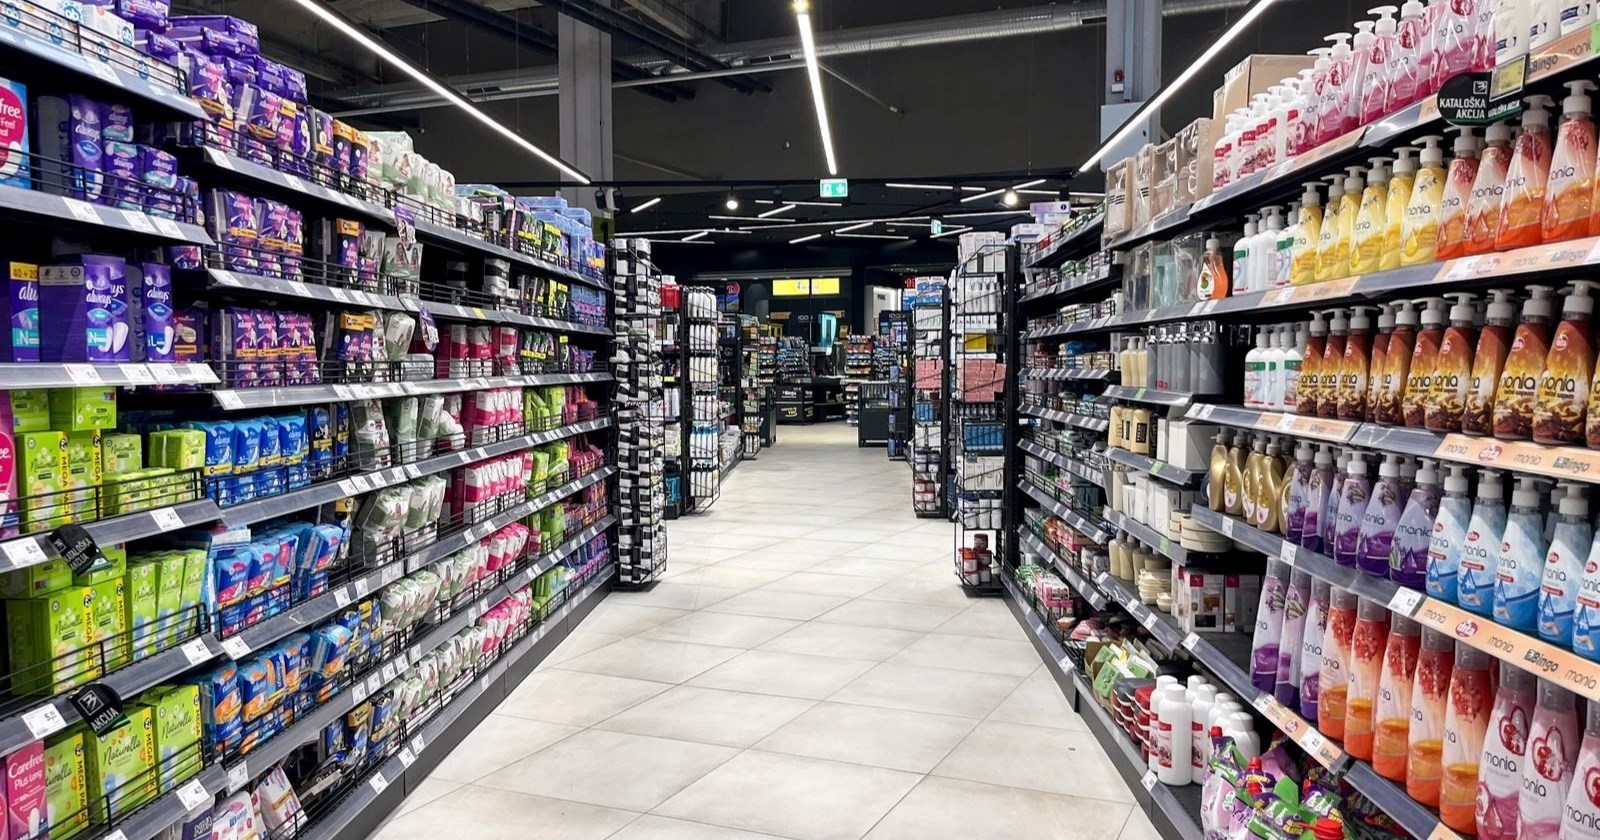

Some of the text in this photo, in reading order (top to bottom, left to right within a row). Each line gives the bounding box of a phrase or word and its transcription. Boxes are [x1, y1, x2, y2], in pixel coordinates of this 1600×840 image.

[1567, 40, 1592, 57] moni
[1532, 54, 1558, 73] Bingo
[1440, 97, 1486, 109] KATALOŠKA
[1456, 109, 1485, 119] AKCIJA
[75, 122, 100, 142] always
[1551, 165, 1576, 181] onia
[1506, 176, 1526, 190] onia
[1442, 197, 1460, 209] onia
[1356, 220, 1371, 231] onia
[86, 292, 112, 308] always
[146, 287, 170, 303] always
[1301, 373, 1318, 384] onia
[1321, 374, 1337, 384] onia
[1341, 373, 1358, 384] onia
[1513, 453, 1542, 466] monia
[1562, 457, 1591, 473] Bingo
[61, 456, 69, 488] MEGA
[1363, 512, 1386, 526] onia
[1431, 536, 1449, 549] onia
[1464, 544, 1487, 558] onia
[1499, 556, 1516, 570] onia
[1545, 567, 1567, 582] onia
[1304, 643, 1322, 656] onia
[1322, 657, 1340, 670] onia
[1488, 635, 1514, 654] monia
[1533, 653, 1559, 674] Bingo
[1565, 668, 1597, 690] monia
[90, 707, 119, 732] AKCIJA
[162, 711, 192, 741] Naturella
[103, 736, 143, 767] Naturella
[145, 733, 153, 762] MEGA
[8, 752, 46, 779] Carefree
[1484, 750, 1517, 773] monia
[14, 769, 43, 791] Plus Long
[77, 761, 88, 821] MEGA PACK
